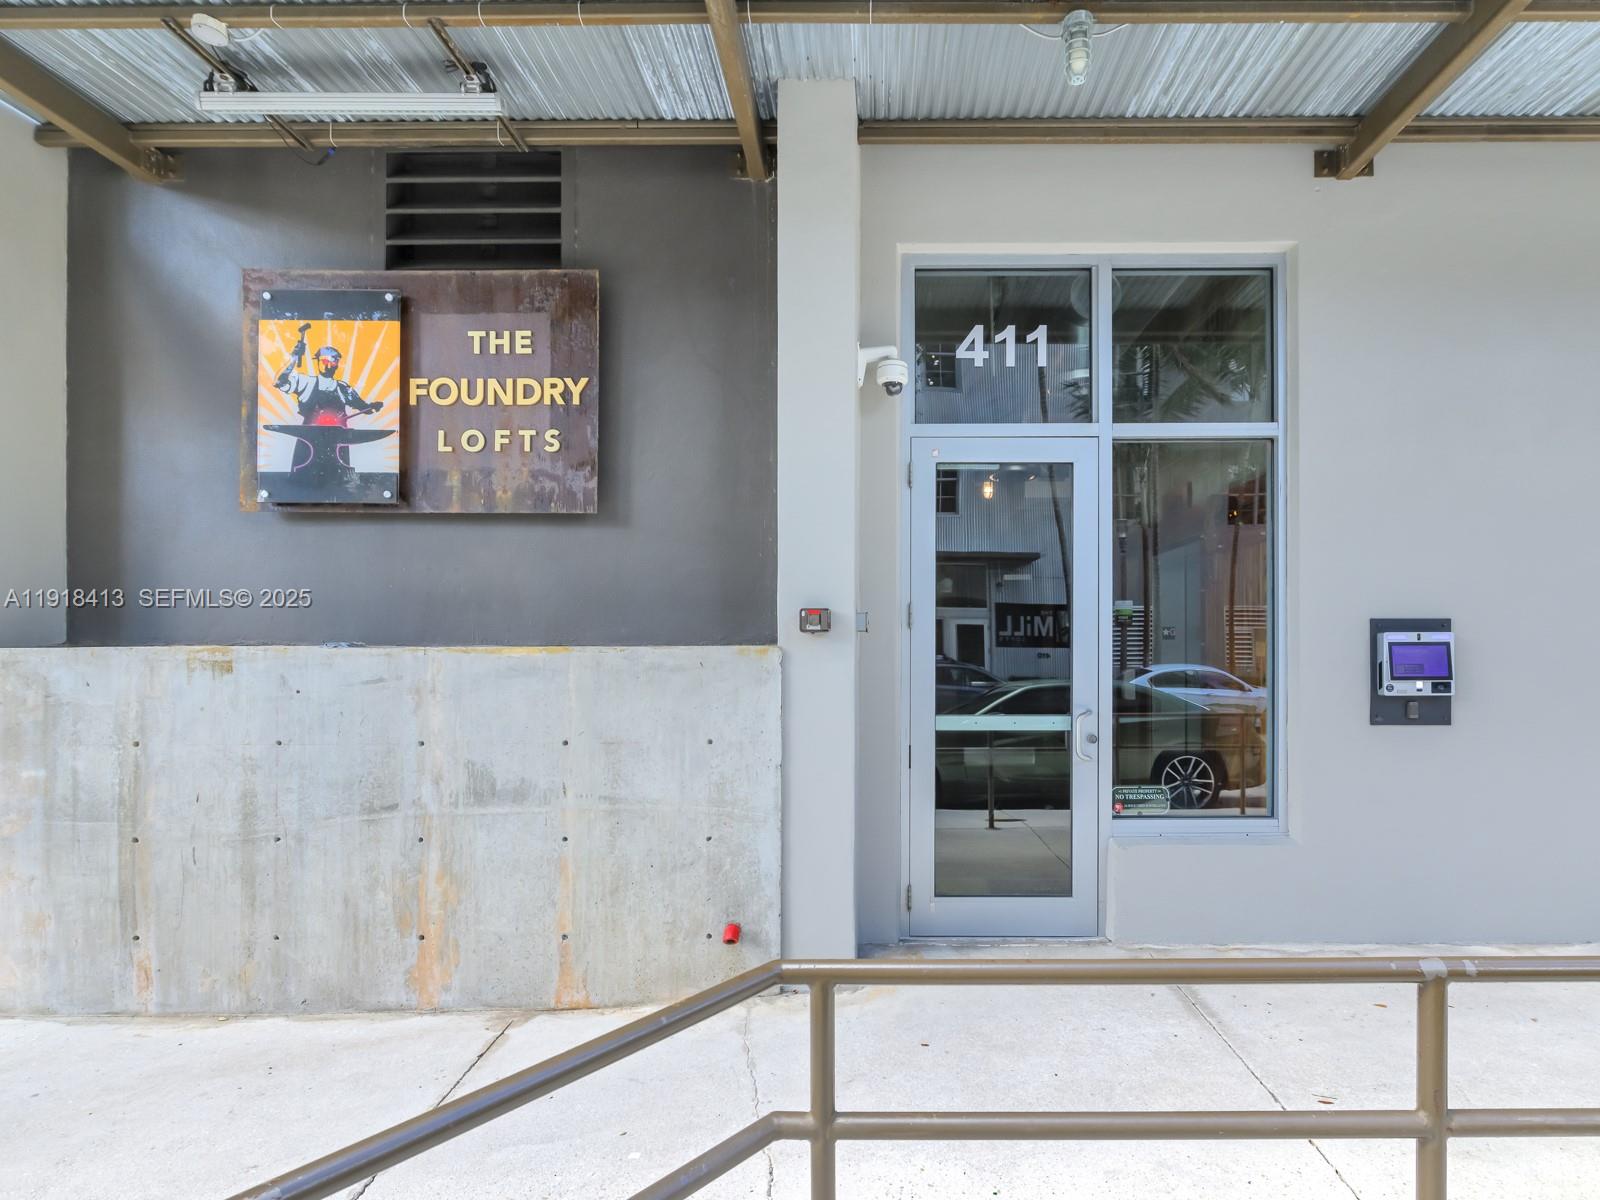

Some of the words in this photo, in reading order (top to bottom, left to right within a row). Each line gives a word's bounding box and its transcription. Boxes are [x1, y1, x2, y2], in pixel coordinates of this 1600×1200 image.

[468, 330, 533, 355] THE
[956, 325, 1048, 367] 411
[409, 377, 590, 406] FOUNDRY
[437, 429, 561, 452] LOFTS
